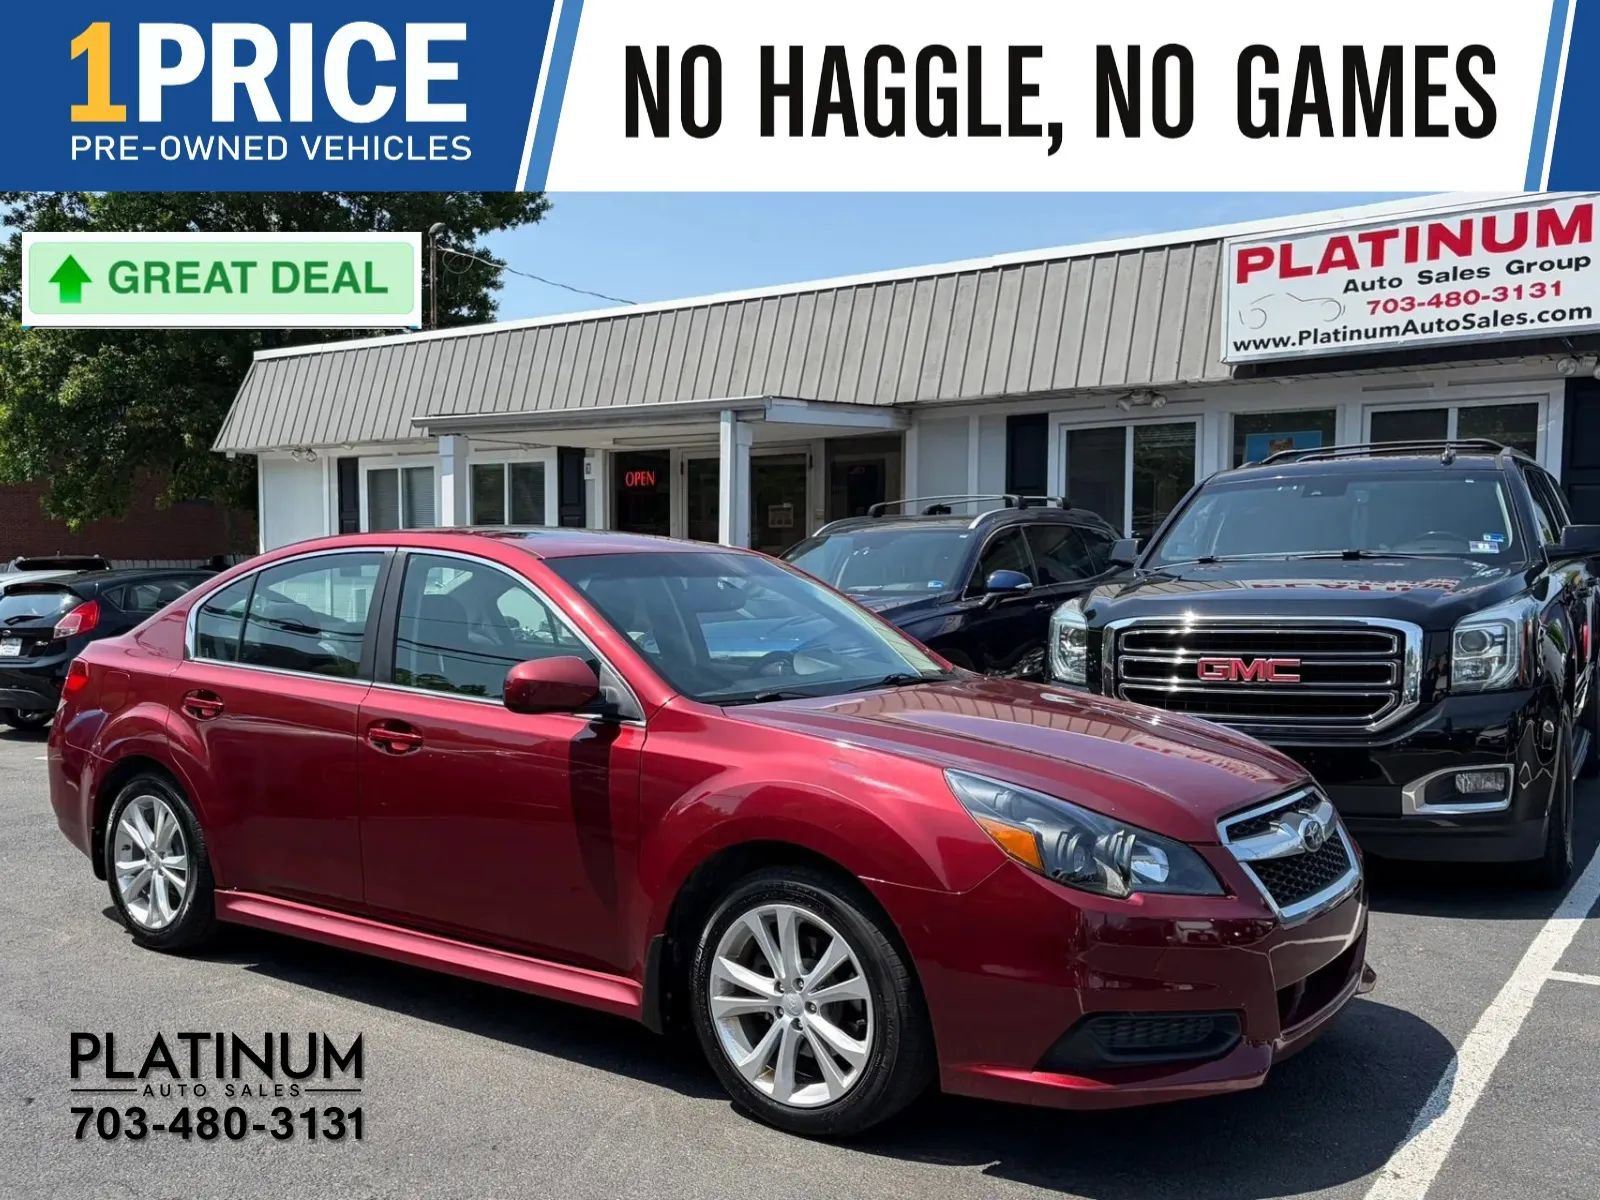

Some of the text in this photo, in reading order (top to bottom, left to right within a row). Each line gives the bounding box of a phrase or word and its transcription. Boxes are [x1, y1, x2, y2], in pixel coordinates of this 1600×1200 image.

[1236, 203, 1593, 284] PLATINUM
[1343, 255, 1591, 294] Auto Sales Group
[1366, 280, 1562, 316] 703-480-3131
[1233, 304, 1593, 352] www.PlatinumAutoSales.com
[625, 470, 656, 487] OPEN
[1198, 657, 1301, 683] GMC
